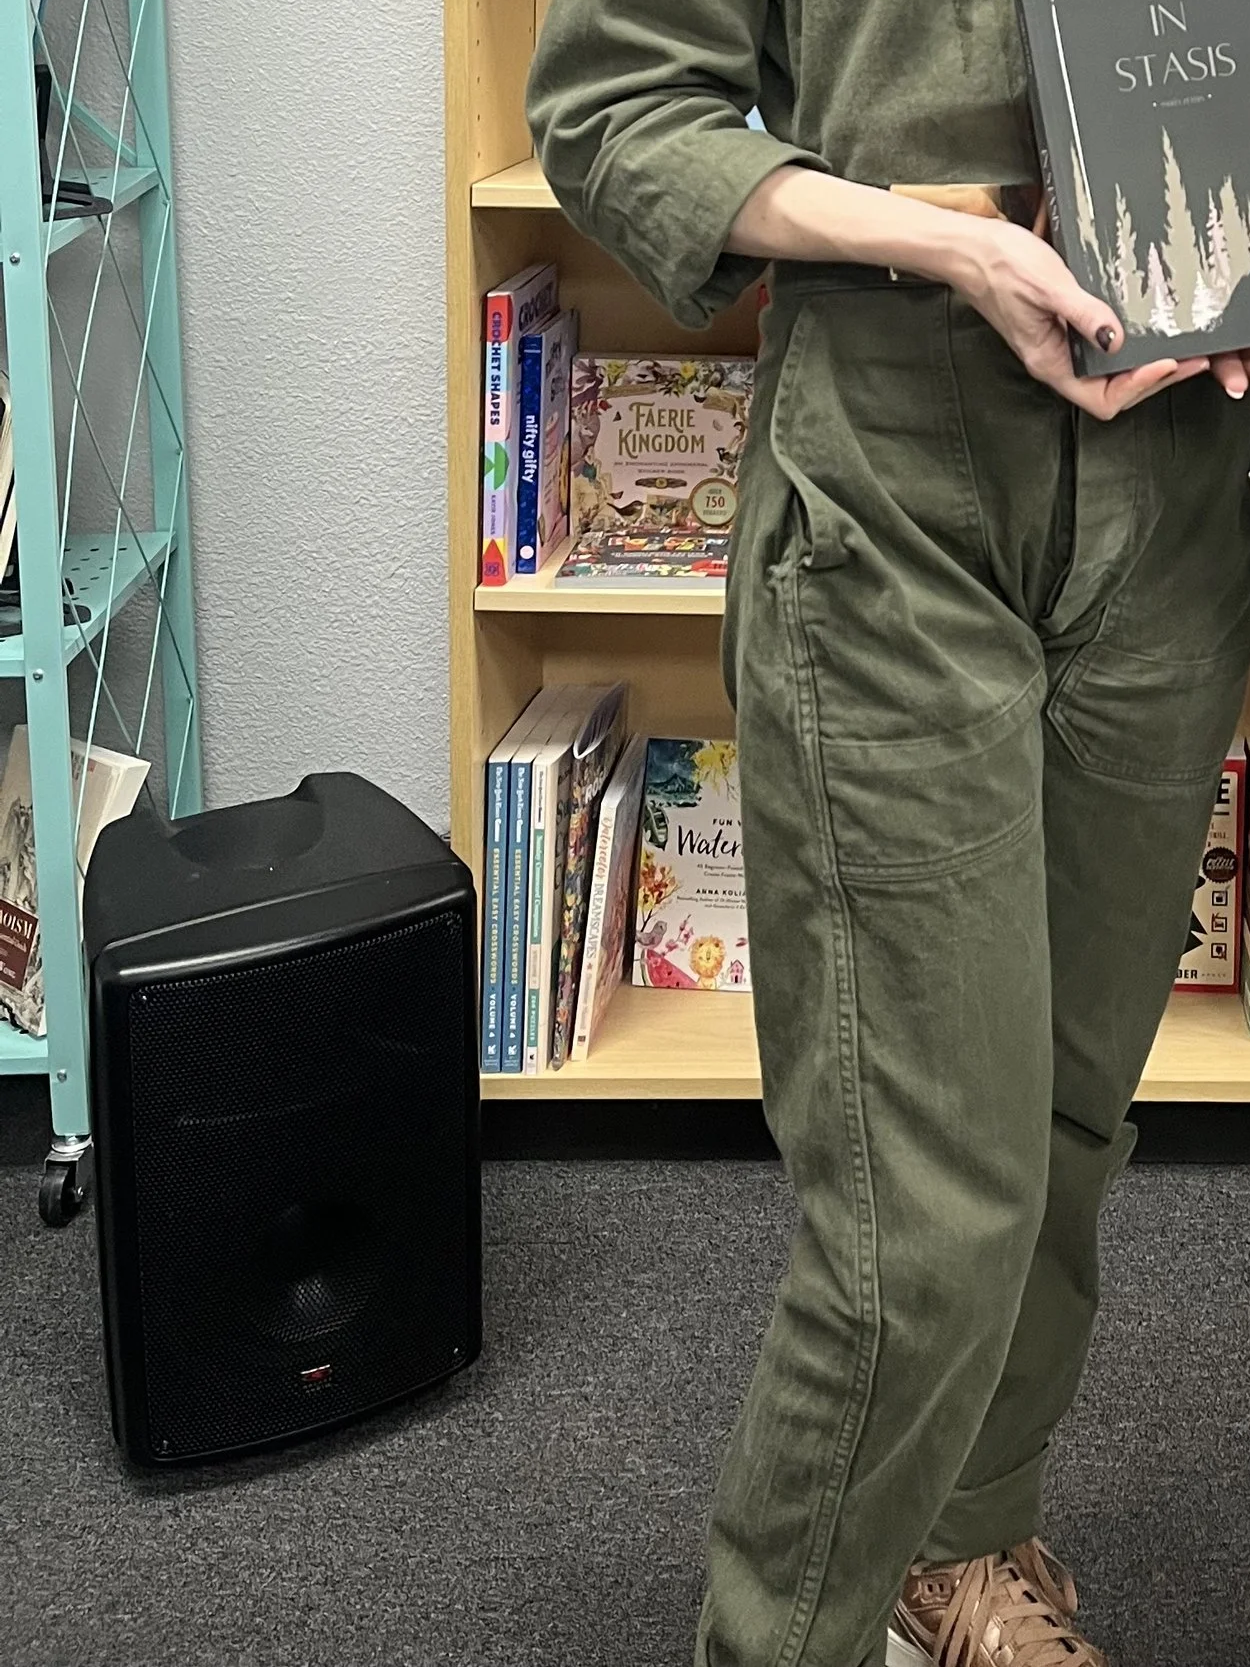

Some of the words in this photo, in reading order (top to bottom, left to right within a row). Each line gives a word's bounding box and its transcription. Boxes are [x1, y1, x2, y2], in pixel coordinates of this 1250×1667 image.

[1148, 1, 1187, 36] IN
[1115, 42, 1237, 93] STASIS
[491, 312, 503, 370] CROCHET
[490, 373, 501, 426] SHAPES
[523, 415, 537, 450] nifty
[629, 402, 695, 433] FAERIE
[618, 429, 705, 459] KINGDOM
[522, 449, 538, 483] gifty
[705, 496, 725, 509] 750
[488, 993, 497, 1031] VOLUME
[509, 993, 518, 1031] VOLUME
